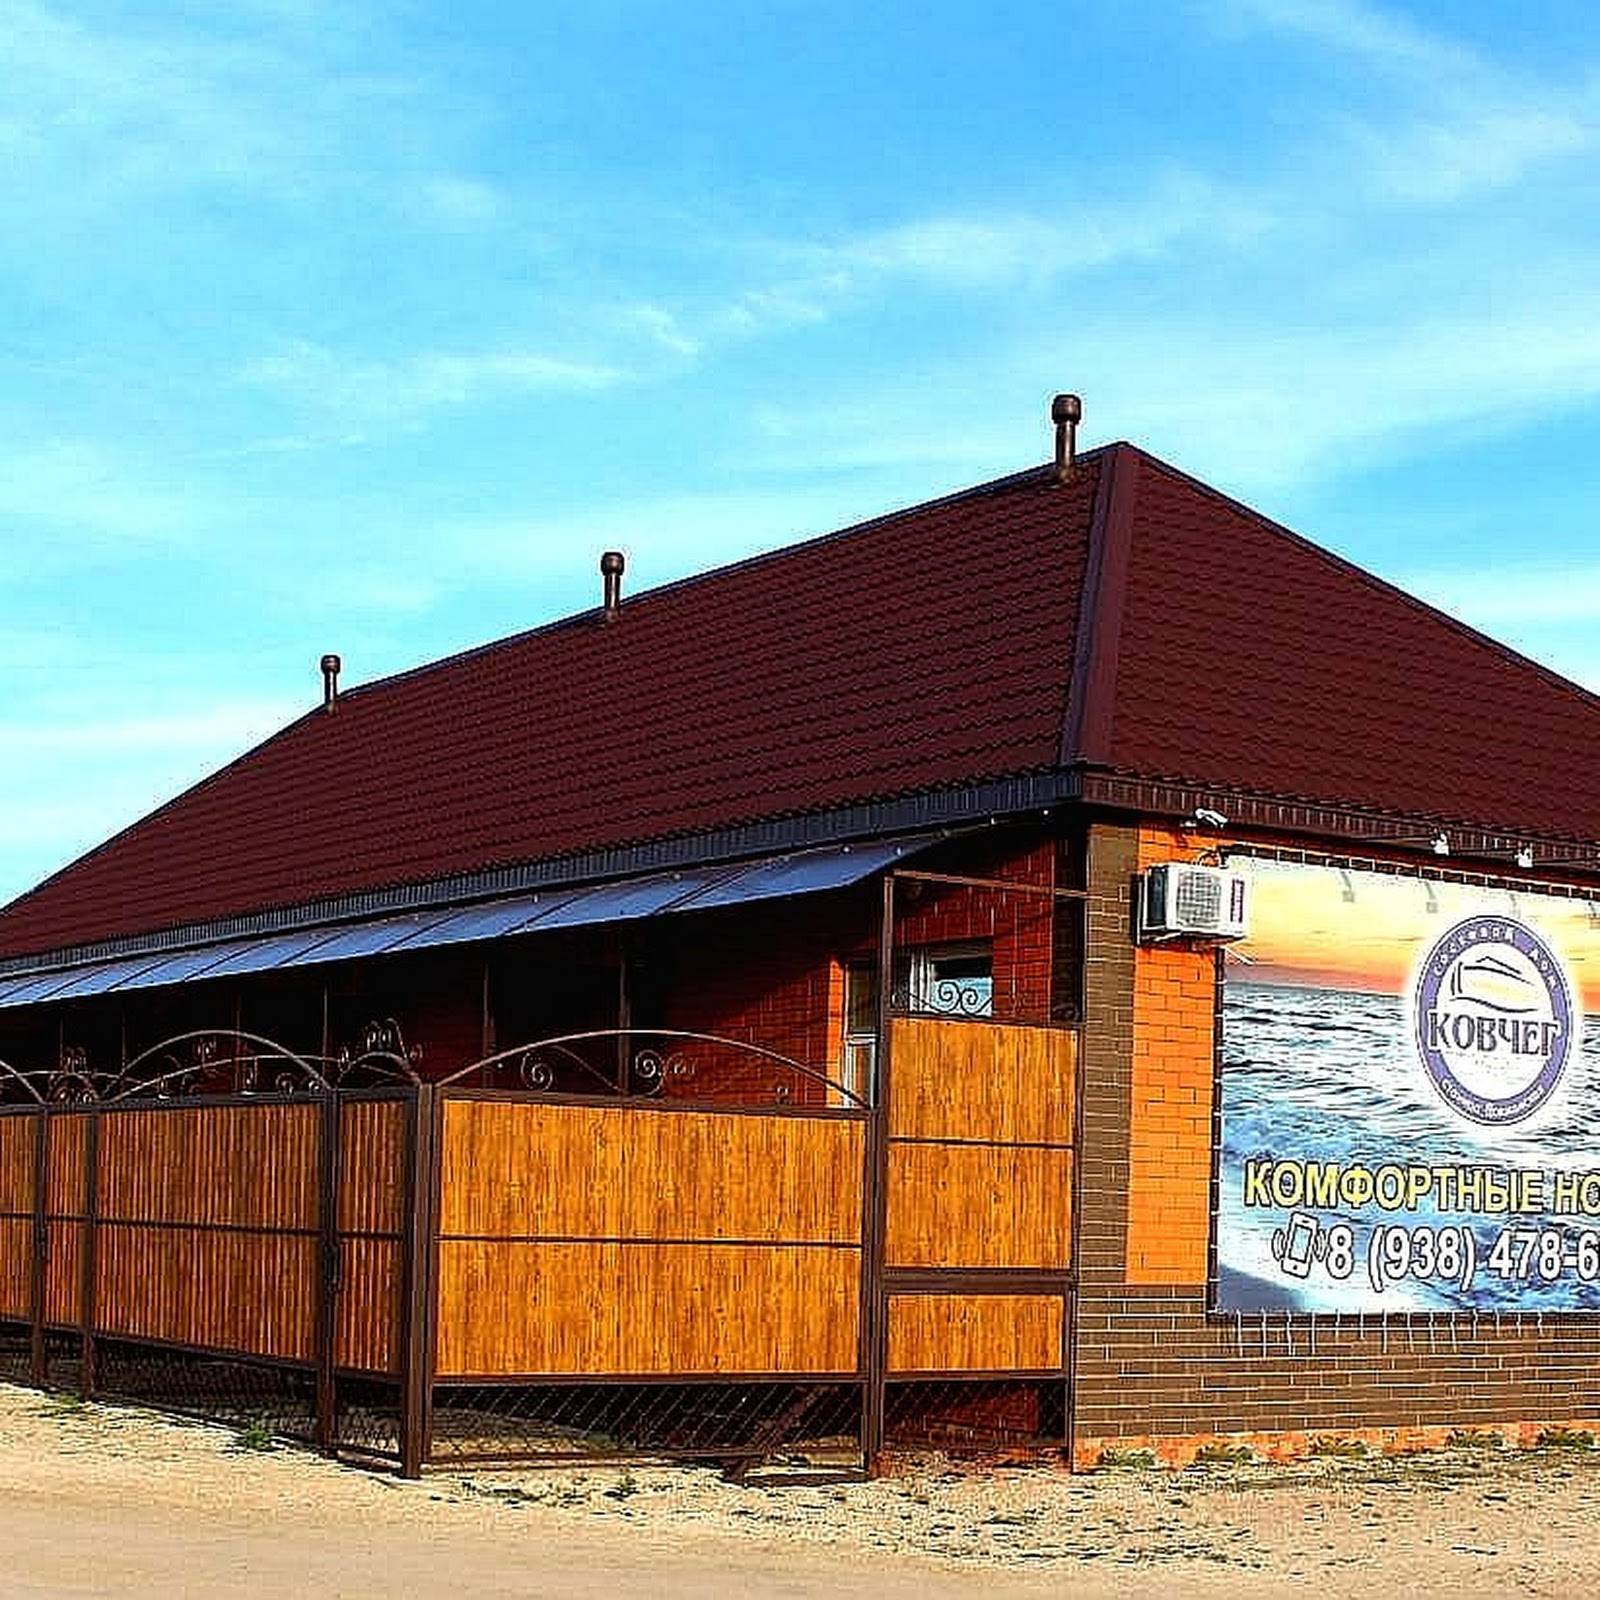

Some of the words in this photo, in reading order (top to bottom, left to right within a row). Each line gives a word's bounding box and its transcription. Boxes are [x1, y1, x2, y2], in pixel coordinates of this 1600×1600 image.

[1429, 1012, 1558, 1056] КОВЧЕГ
[1244, 1159, 1545, 1214] КОМФОРТНЫЕ
[1326, 1225, 1354, 1279] 8
[1368, 1225, 1476, 1293] (938)
[1488, 1228, 1600, 1281] 478-6
